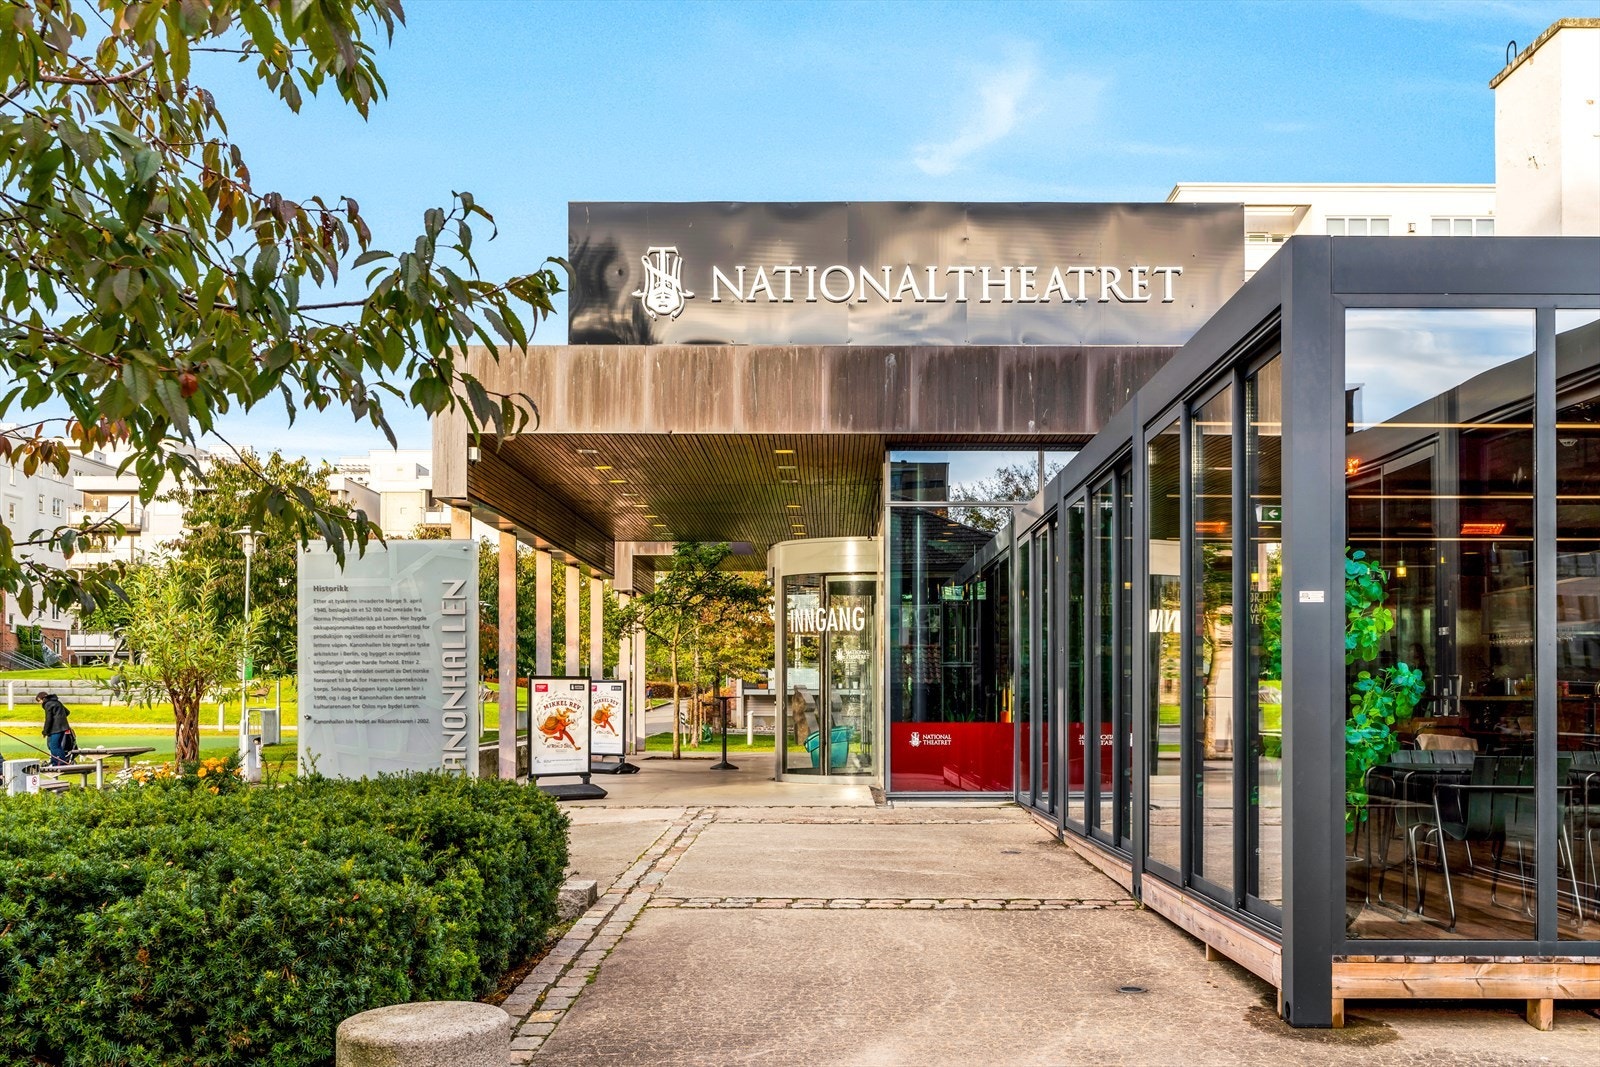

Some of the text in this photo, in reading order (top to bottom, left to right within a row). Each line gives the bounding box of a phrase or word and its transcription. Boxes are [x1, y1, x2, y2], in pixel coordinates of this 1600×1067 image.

[711, 264, 1183, 303] NATIONALTHEATRET
[790, 606, 865, 632] INNGANG
[442, 579, 467, 771] ANONHALLEN
[544, 700, 581, 710] MIKKEL REV
